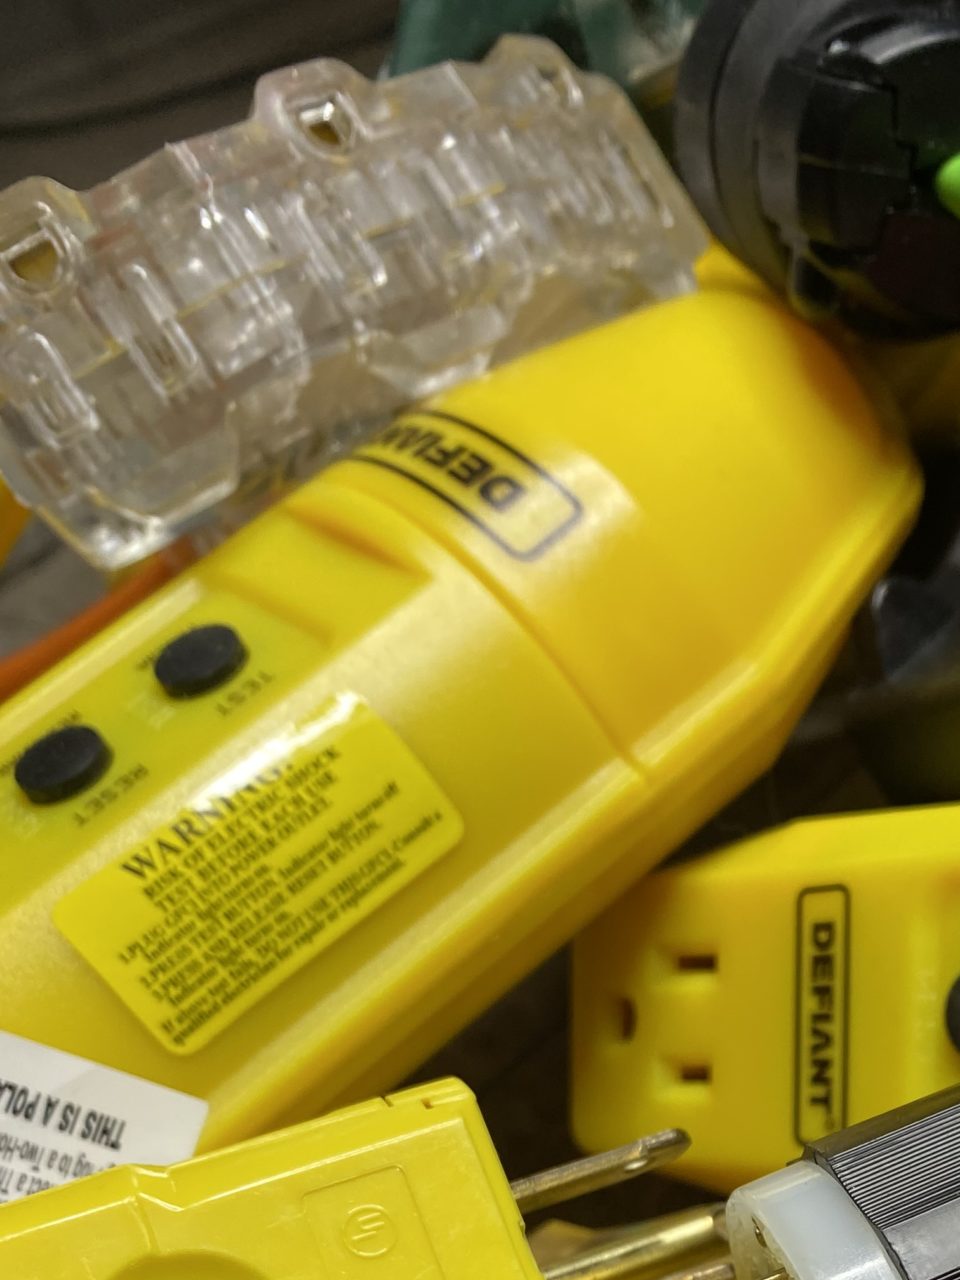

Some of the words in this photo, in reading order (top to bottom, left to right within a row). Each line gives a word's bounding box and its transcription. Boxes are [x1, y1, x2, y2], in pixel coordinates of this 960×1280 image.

[380, 424, 525, 514] DEFIA
[141, 863, 184, 900] RISK
[180, 846, 207, 871] OF
[282, 744, 340, 792] SHOCK
[808, 920, 837, 1115] DEFIANT
[42, 1094, 61, 1127] A
[58, 1100, 82, 1135] IS
[80, 1108, 126, 1151] THIS
